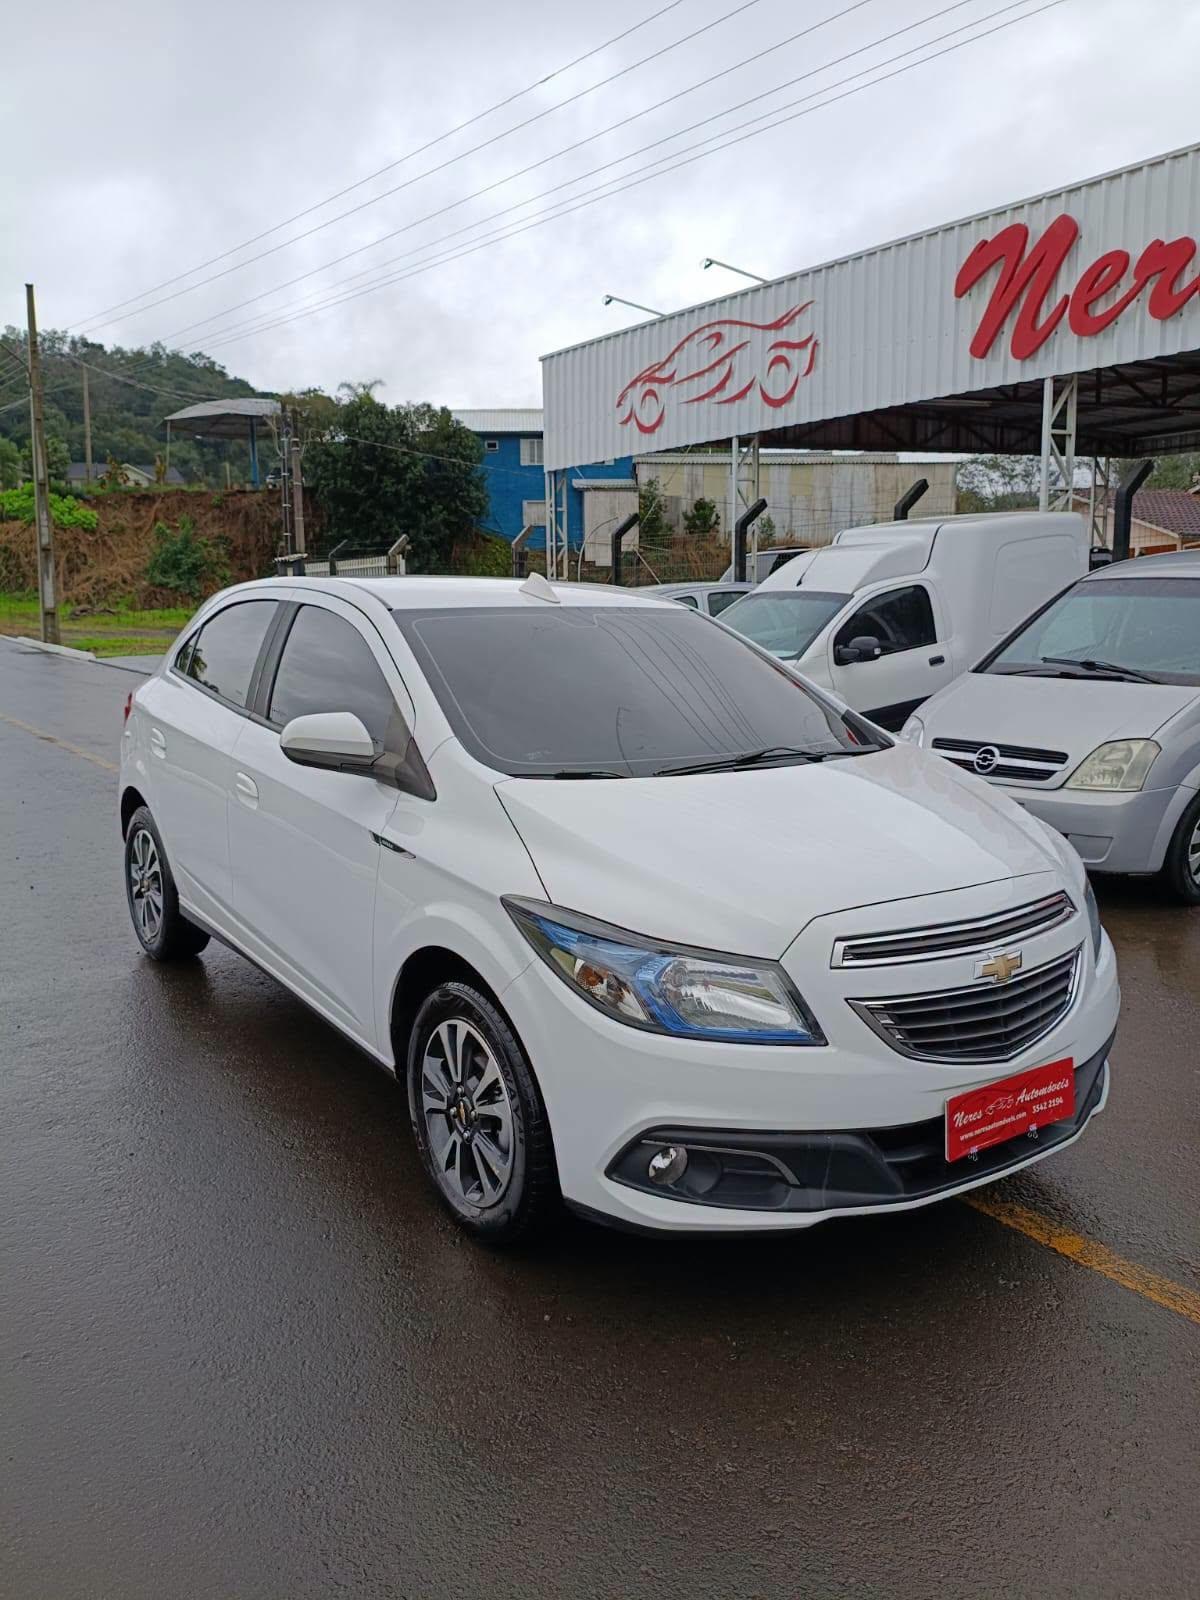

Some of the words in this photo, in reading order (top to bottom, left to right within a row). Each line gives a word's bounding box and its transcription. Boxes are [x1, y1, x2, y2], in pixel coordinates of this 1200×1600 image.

[954, 213, 1200, 361] Ner
[954, 1110, 982, 1127] Neres
[1016, 1078, 1069, 1105] Automóveis
